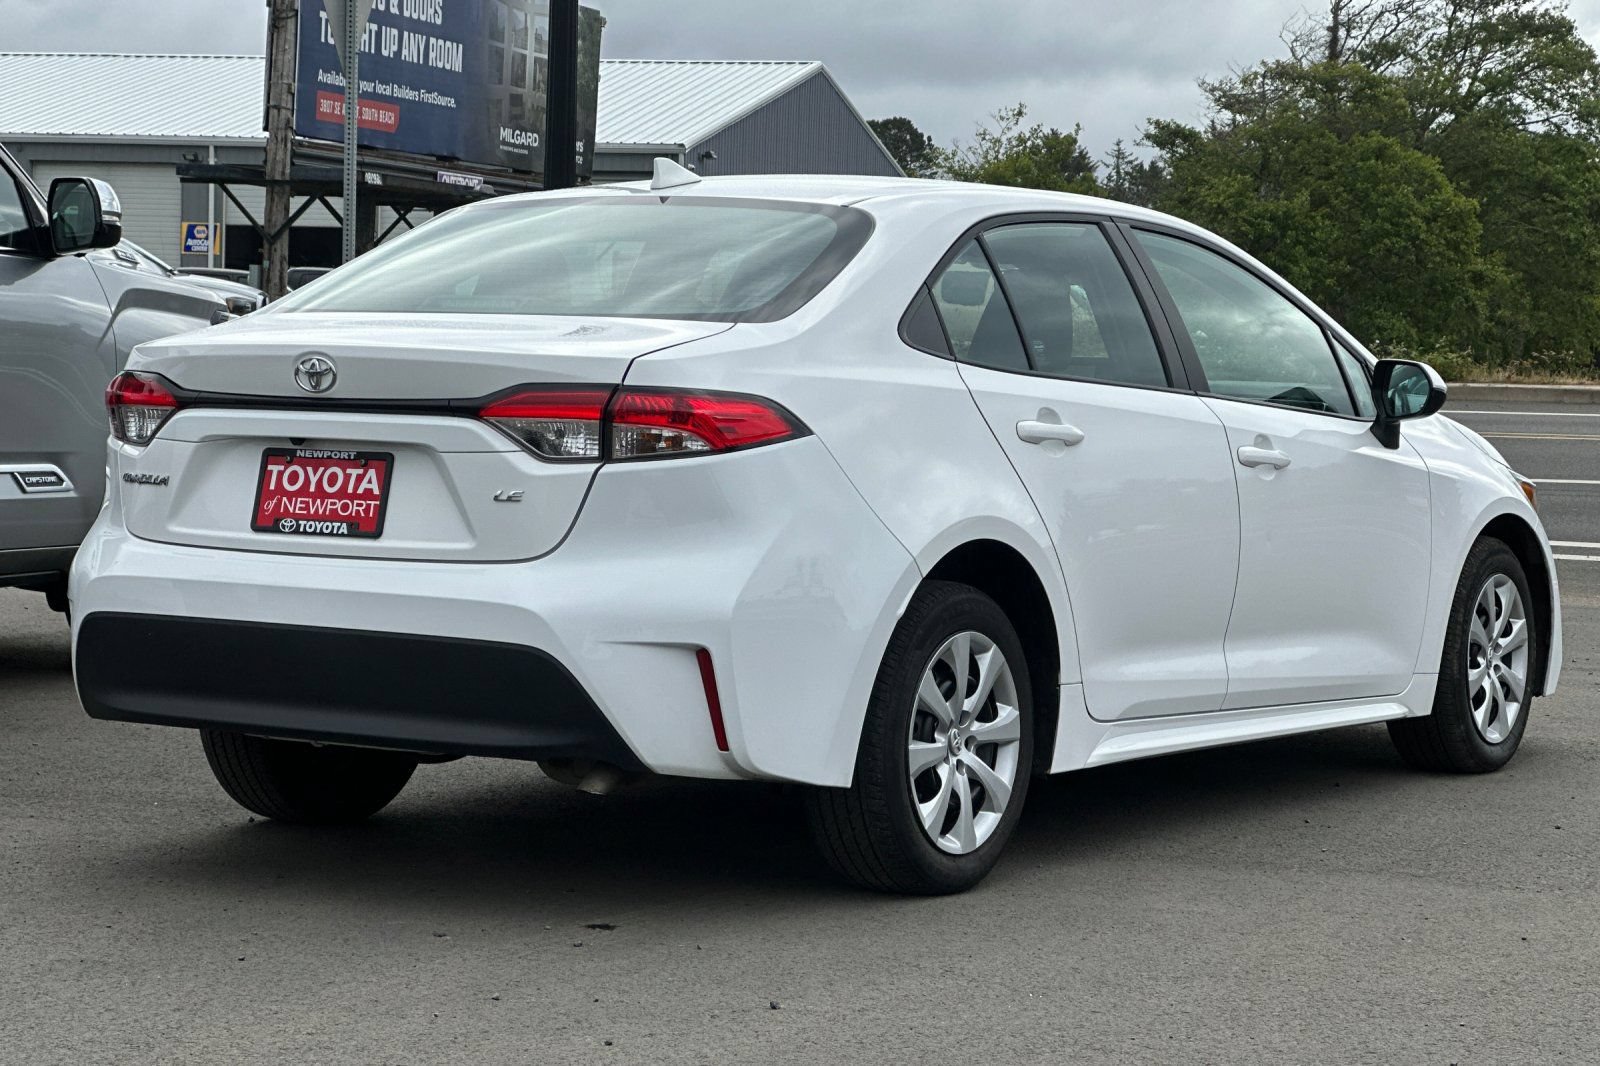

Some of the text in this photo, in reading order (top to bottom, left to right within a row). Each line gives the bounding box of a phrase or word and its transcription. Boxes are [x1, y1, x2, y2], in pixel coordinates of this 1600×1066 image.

[403, 0, 442, 25] DOORS
[381, 25, 398, 58] UP
[401, 30, 426, 64] ANY
[428, 37, 463, 72] ROOM
[317, 68, 457, 108] Availab your local Builders FirstSource.
[333, 102, 341, 115] SE
[361, 107, 378, 121] SOUTH
[379, 110, 395, 124] BEACH
[500, 126, 539, 147] MILGARD
[296, 449, 357, 459] NEWPORT
[267, 464, 380, 495] TOYOTA
[264, 495, 380, 517] of NEWPORT
[493, 490, 525, 502] LE
[299, 520, 348, 535] TOYOTA
